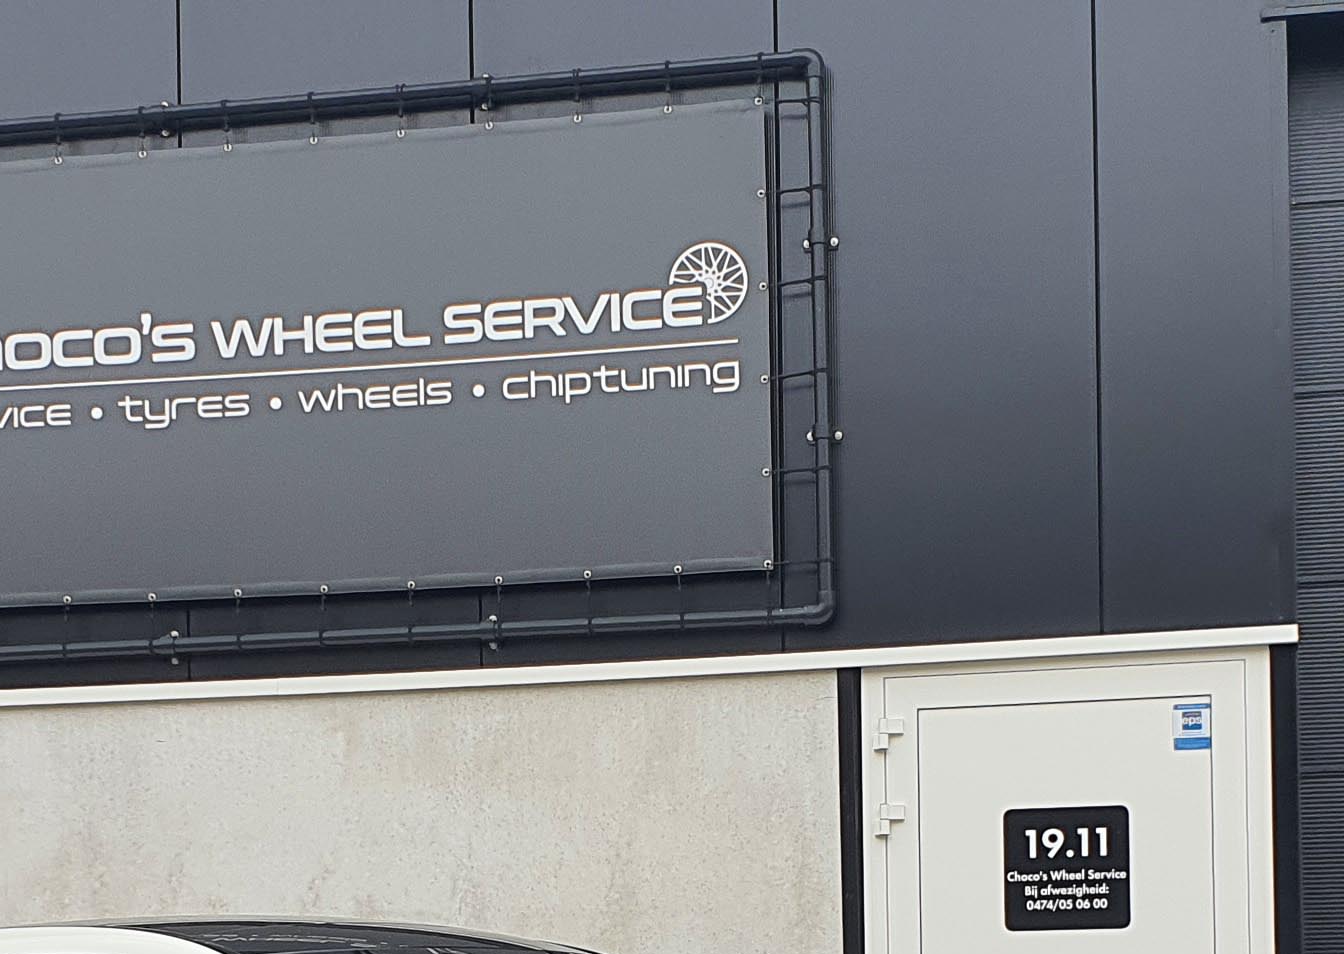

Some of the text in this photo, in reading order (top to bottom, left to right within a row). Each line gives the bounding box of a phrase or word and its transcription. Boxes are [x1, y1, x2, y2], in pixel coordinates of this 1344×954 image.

[210, 309, 432, 359] WHEEL
[443, 286, 704, 345] SERVICE
[117, 394, 250, 430] tyres
[297, 377, 452, 413] wheels
[502, 360, 740, 404] chiptuning
[1025, 827, 1107, 859] 19.11
[1007, 869, 1127, 882] Choco's Wheel Service
[1024, 883, 1110, 898] Bij afwezigheid:
[1026, 898, 1108, 912] 0474/05 06 00
